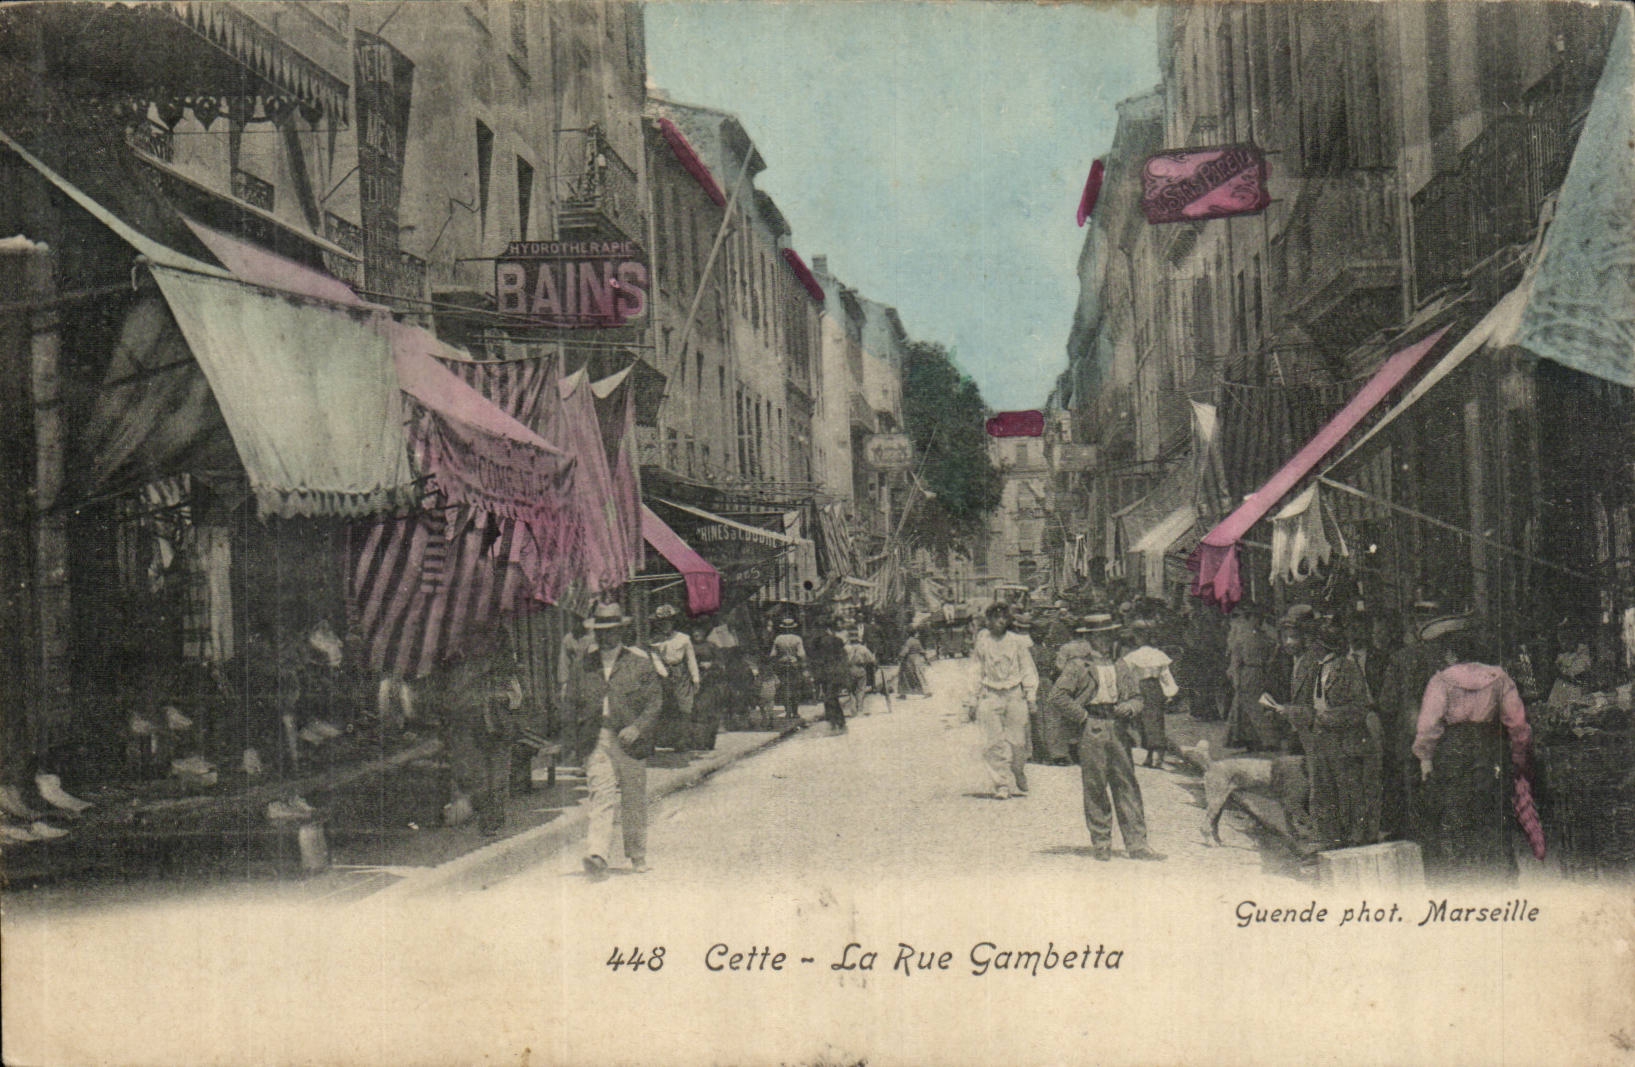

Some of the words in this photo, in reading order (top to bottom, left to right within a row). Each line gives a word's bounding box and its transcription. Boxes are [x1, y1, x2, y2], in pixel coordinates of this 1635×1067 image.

[1198, 150, 1253, 190] PAREIL
[510, 241, 634, 256] HYDROTHERAPIE
[498, 261, 650, 323] BAINS
